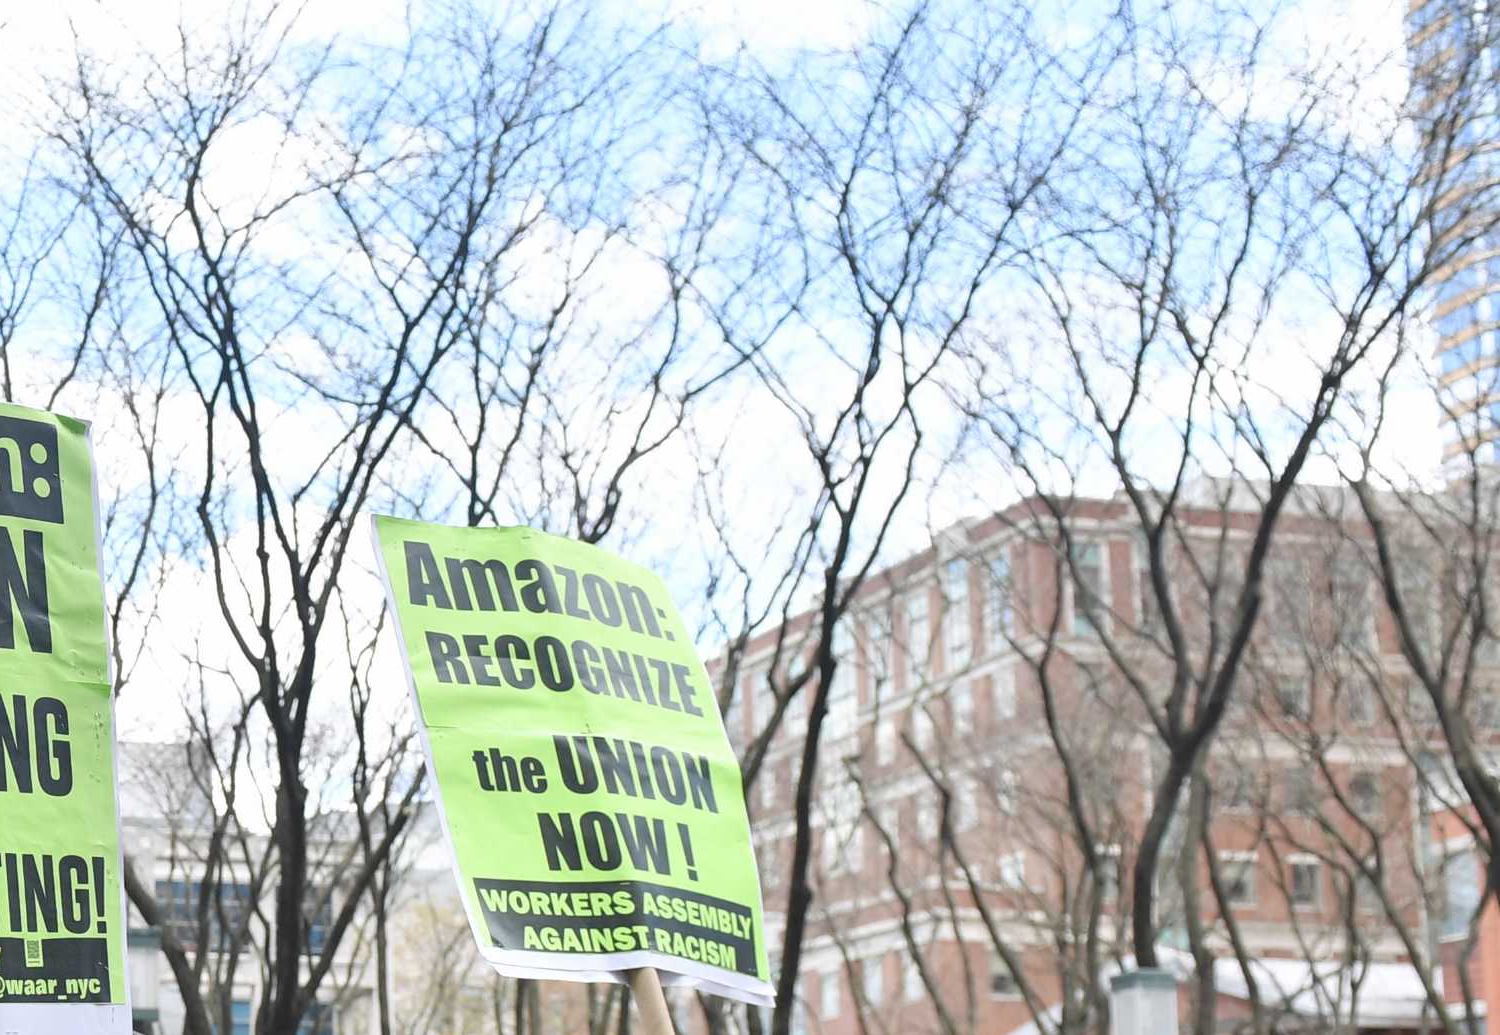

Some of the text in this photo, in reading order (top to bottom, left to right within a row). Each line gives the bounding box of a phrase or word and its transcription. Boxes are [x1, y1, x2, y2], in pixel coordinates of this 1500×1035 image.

[403, 540, 676, 641] Amazon:
[425, 630, 704, 718] RECOGNIZE
[472, 734, 719, 814] the UNION
[478, 887, 752, 941] WORKERS ASSEMBLY
[523, 926, 737, 970] AGAINST RACISM
